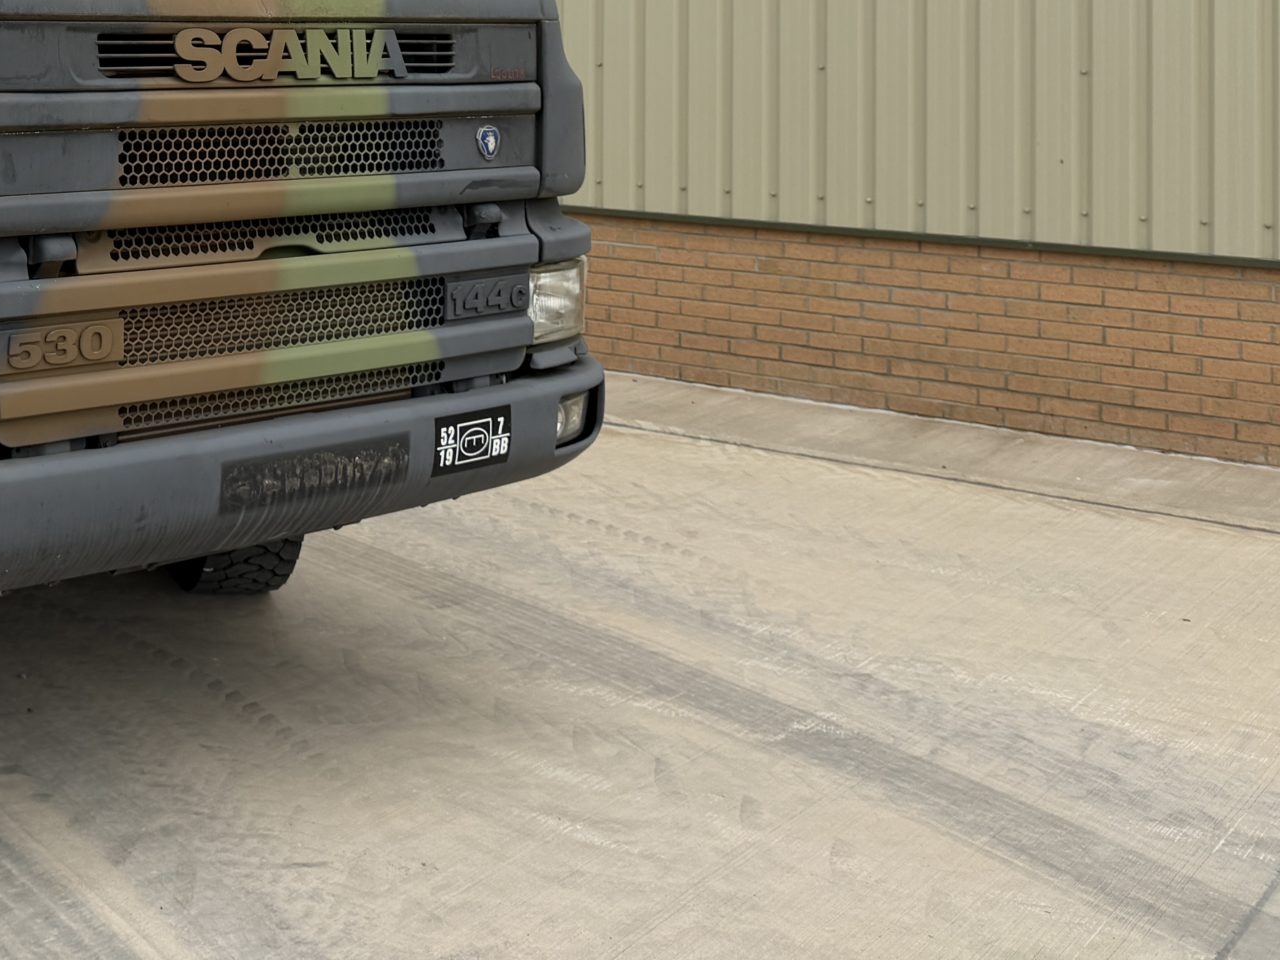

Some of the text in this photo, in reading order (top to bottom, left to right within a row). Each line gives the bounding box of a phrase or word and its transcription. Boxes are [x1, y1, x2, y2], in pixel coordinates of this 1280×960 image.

[173, 26, 408, 83] SCANIA
[7, 324, 114, 370] 530
[496, 416, 505, 435] 7
[440, 426, 455, 446] 52
[491, 437, 509, 457] BB
[439, 448, 454, 467] 19
